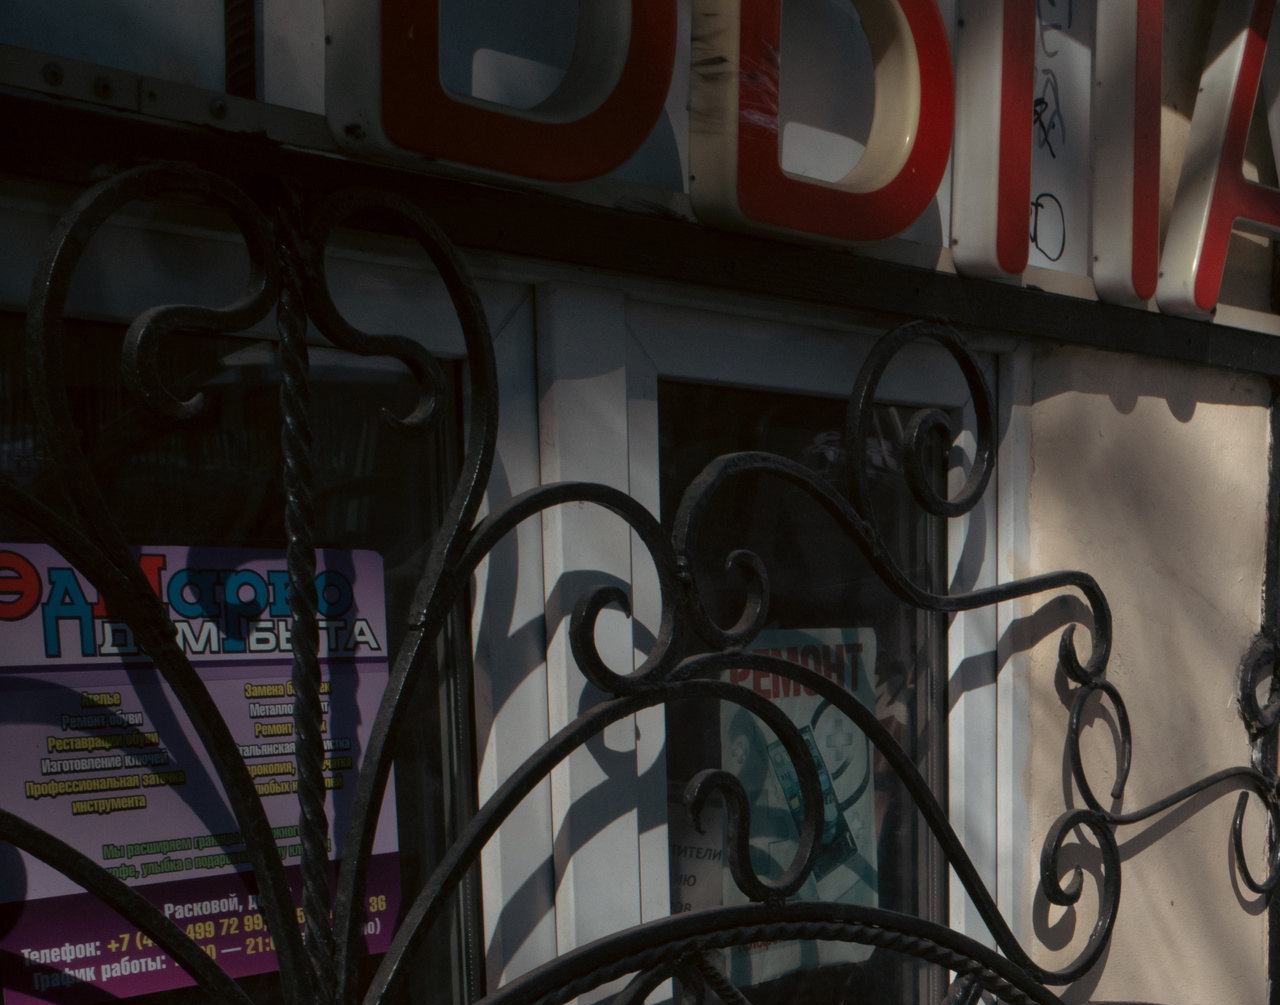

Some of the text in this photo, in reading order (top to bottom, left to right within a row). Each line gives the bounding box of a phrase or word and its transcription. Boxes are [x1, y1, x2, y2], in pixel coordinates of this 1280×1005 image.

[98, 618, 223, 656] ДМ
[81, 691, 121, 708] Ателье
[244, 682, 285, 699] Замена
[61, 709, 143, 730] Ремонт обуви
[254, 721, 293, 739] Ремонт
[126, 729, 159, 749] обуви
[236, 742, 297, 759] тальянская
[41, 749, 169, 775] Изготовление ключей
[25, 771, 186, 800] Профессиональная заточка
[72, 795, 147, 815] инструмента
[102, 844, 125, 860] Мы
[126, 838, 192, 859] расширяем
[141, 856, 184, 878] улыбка
[164, 892, 243, 919] Расковой,
[21, 941, 102, 967] Телефон:
[107, 933, 131, 953] +7
[186, 920, 216, 941] 499
[219, 917, 240, 936] 72
[369, 895, 386, 912] 36
[33, 966, 97, 993] График
[101, 955, 168, 983] работы:
